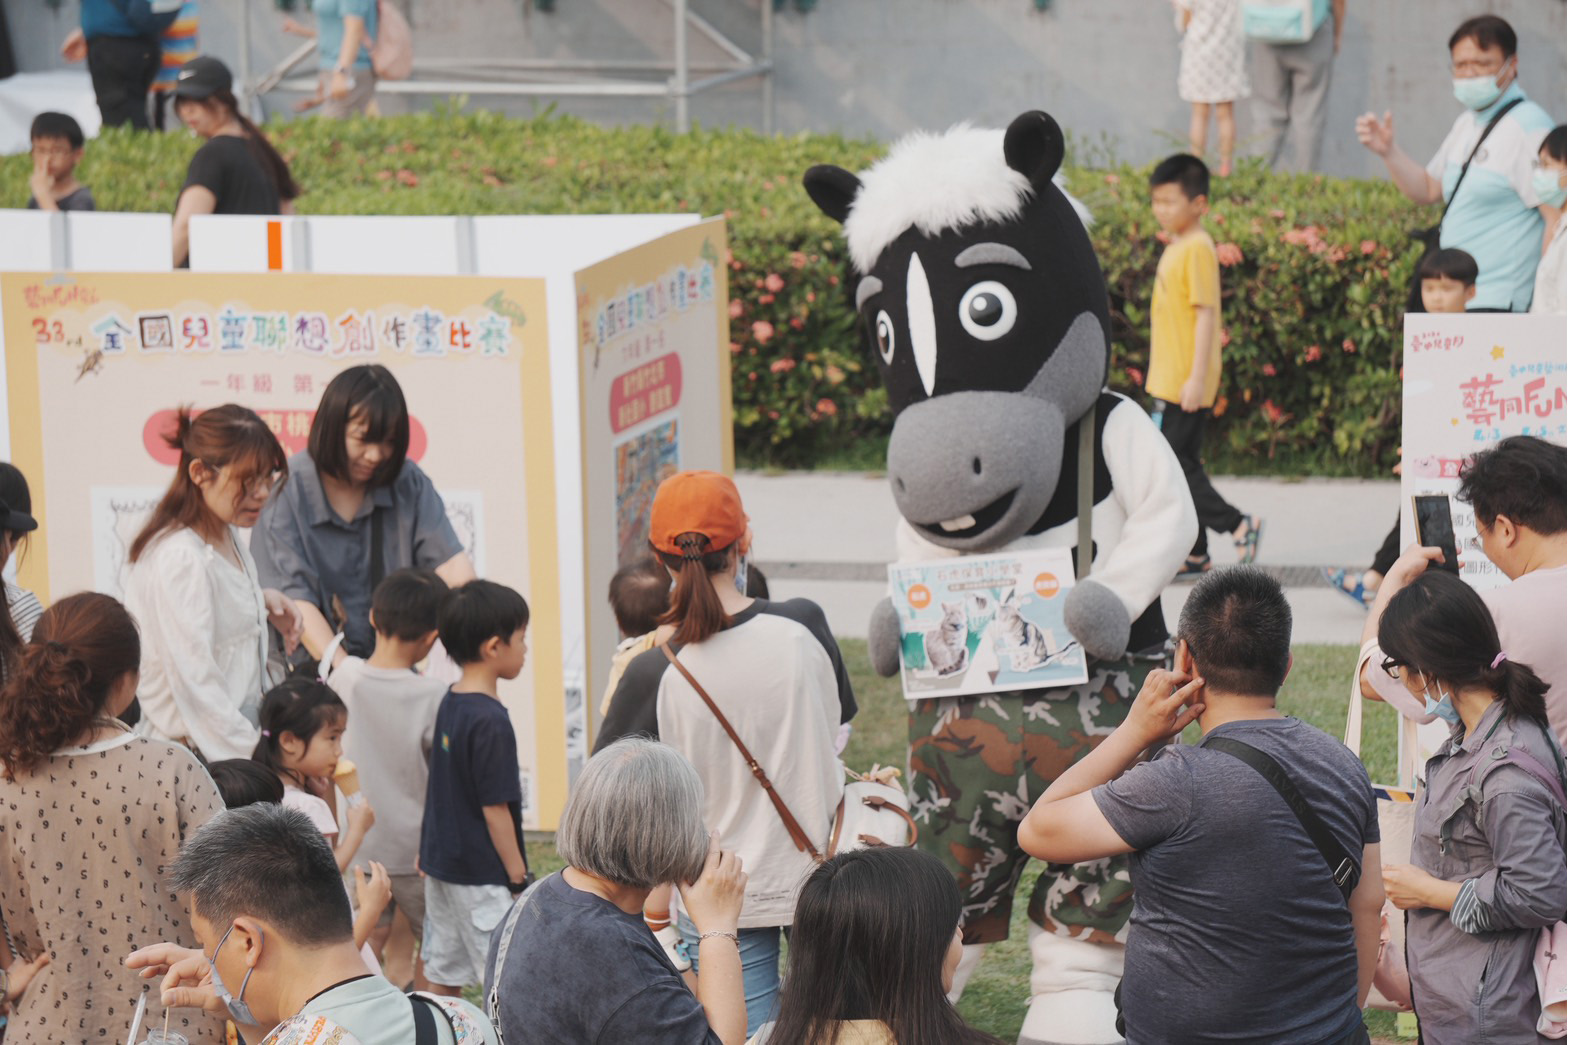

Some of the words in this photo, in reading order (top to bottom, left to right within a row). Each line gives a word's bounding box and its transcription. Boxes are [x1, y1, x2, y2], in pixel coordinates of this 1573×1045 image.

[94, 310, 508, 353] 全國兒童聯想創作畫比賽
[202, 373, 272, 393] 一年級
